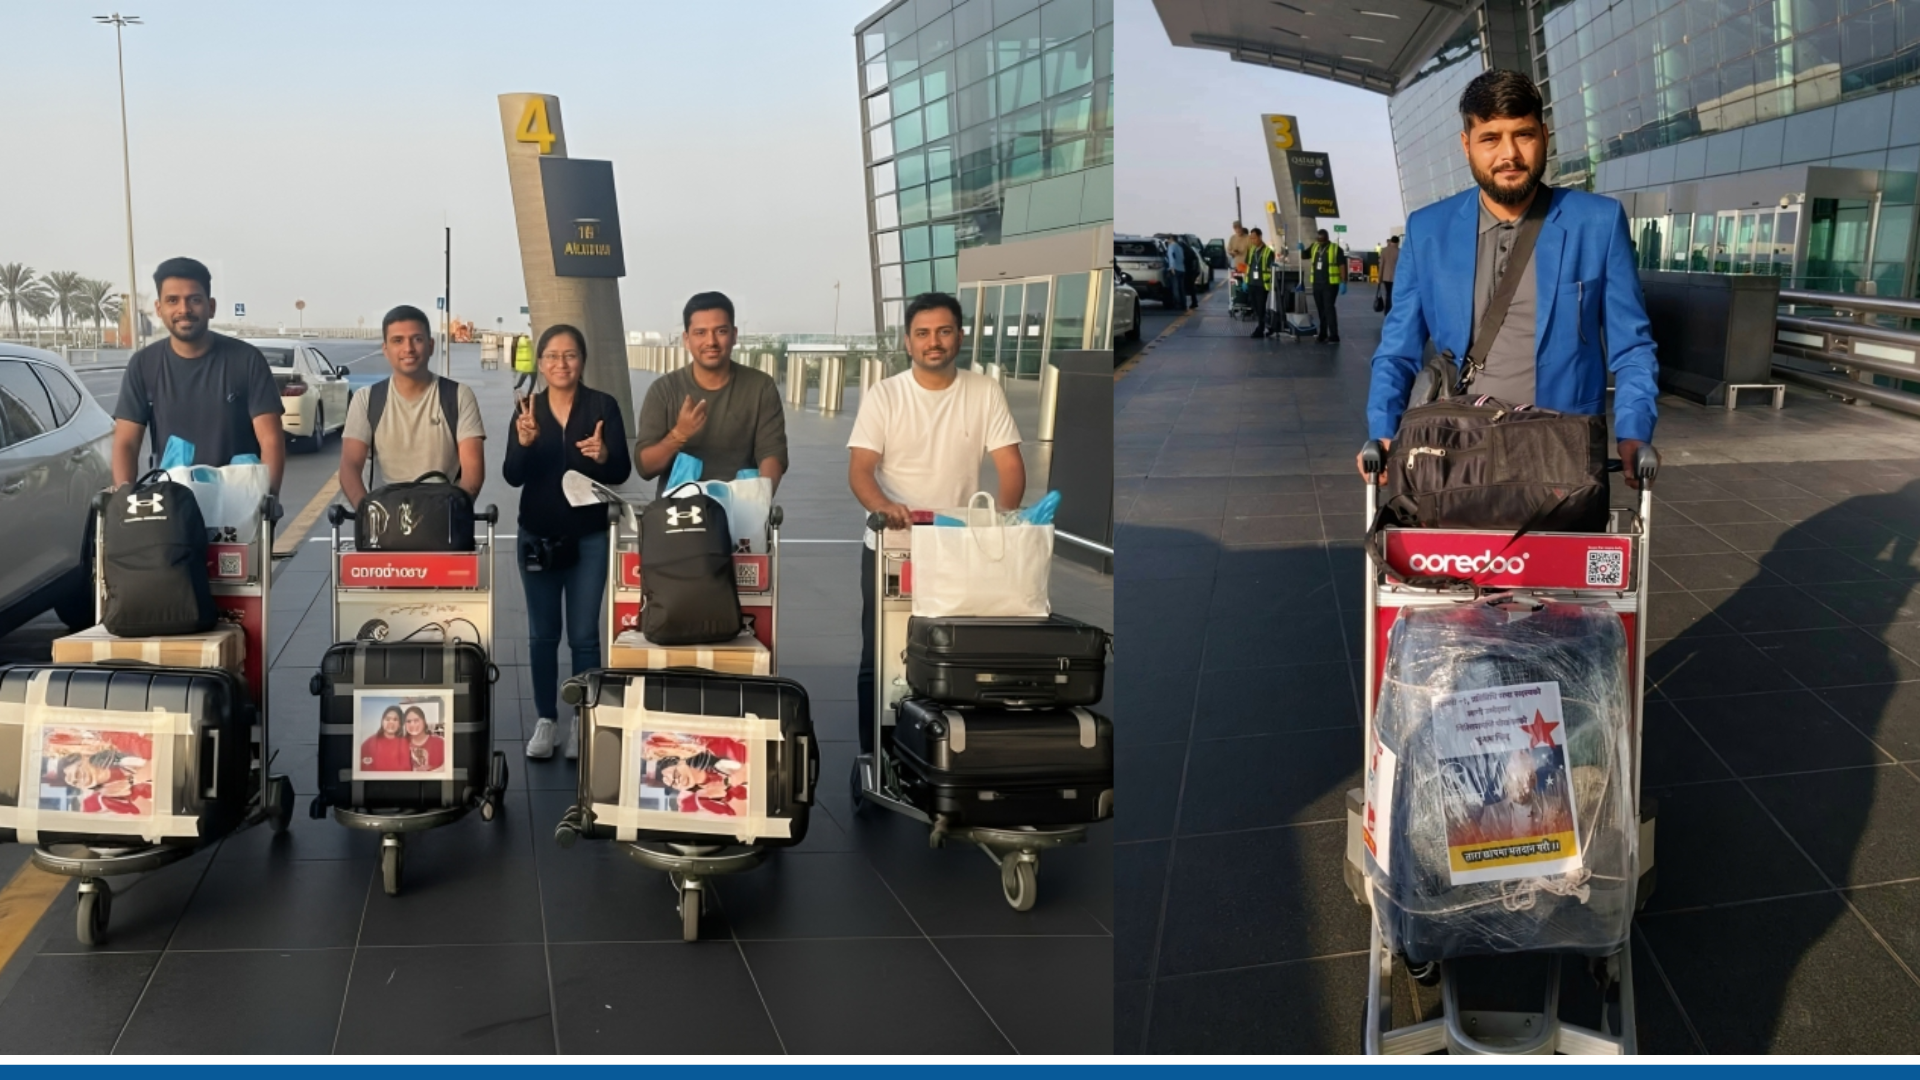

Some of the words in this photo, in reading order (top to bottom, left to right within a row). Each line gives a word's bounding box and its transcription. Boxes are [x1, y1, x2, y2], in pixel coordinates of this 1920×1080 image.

[516, 96, 556, 154] 4
[1270, 115, 1294, 149] 3
[1291, 156, 1315, 165] QATAR
[1302, 197, 1334, 207] Economy
[1409, 549, 1525, 575] ooredoo
